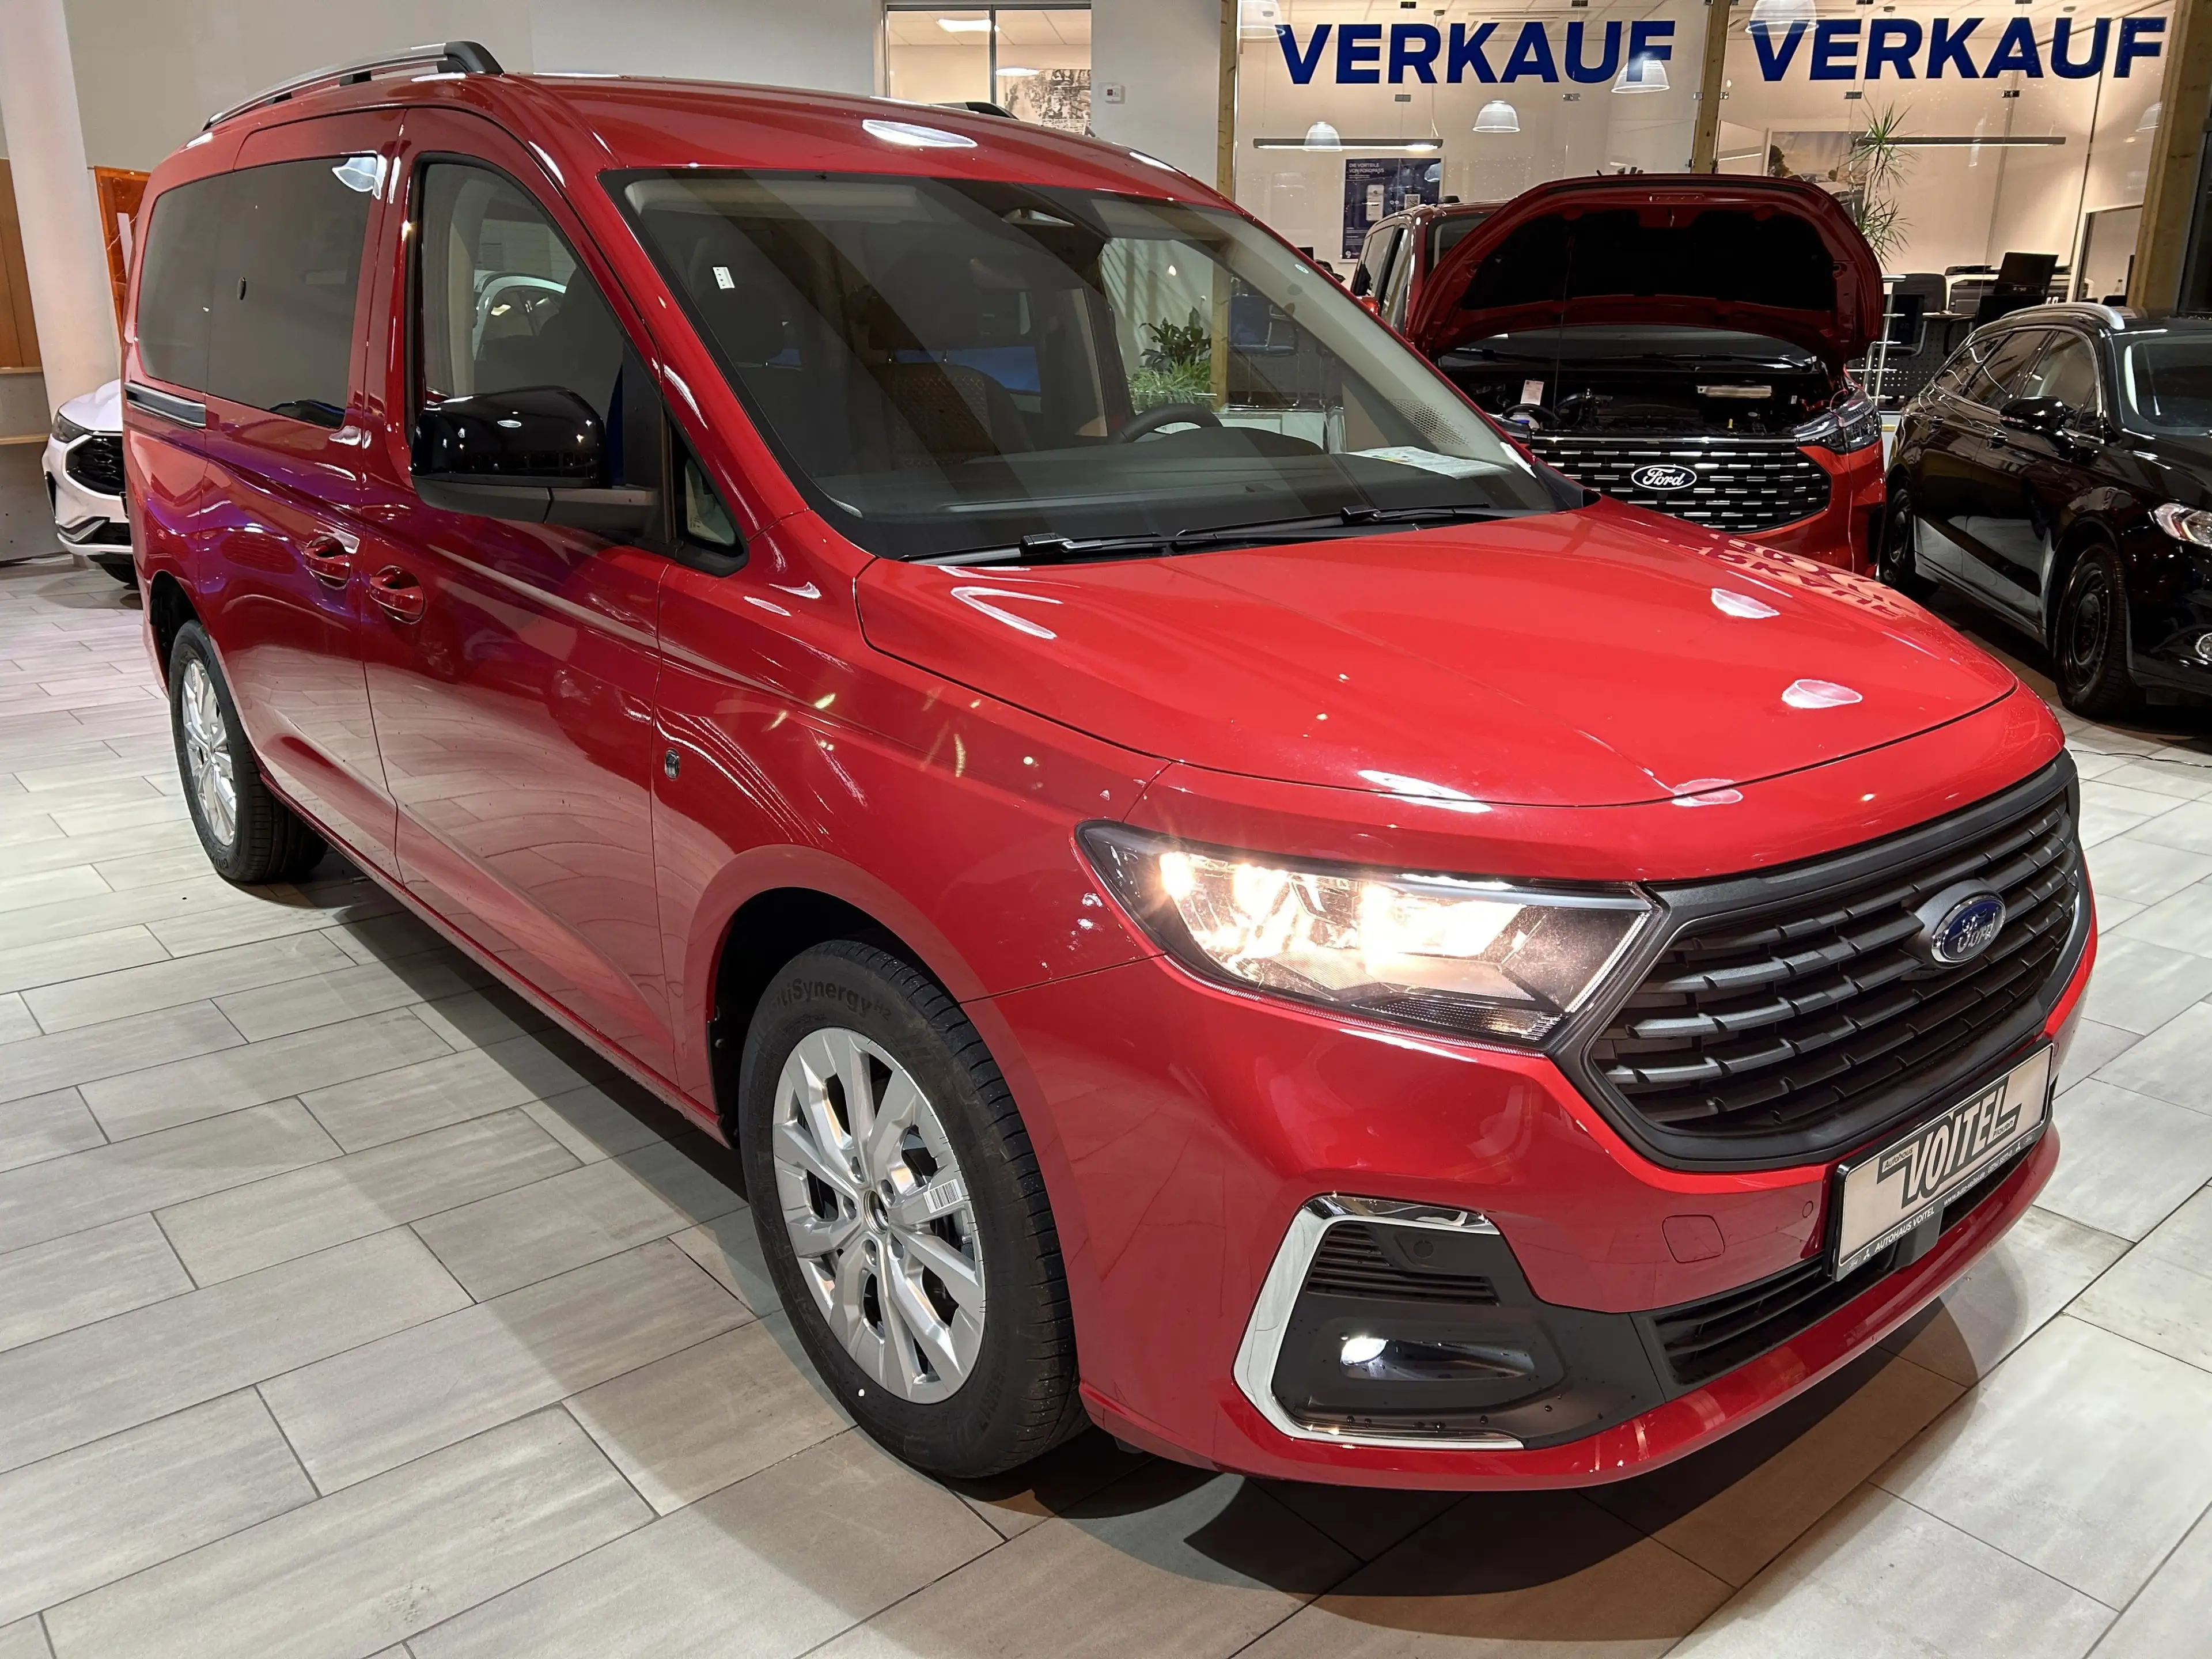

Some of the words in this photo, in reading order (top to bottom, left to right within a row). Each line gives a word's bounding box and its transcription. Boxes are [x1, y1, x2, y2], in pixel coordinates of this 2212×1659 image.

[1274, 20, 1676, 85] VERKAUF
[1749, 16, 2167, 82] VERKAUF
[1642, 467, 1686, 486] Ford
[1957, 908, 1996, 953] Ford
[1895, 1082, 2010, 1201] VOITEL
[1993, 1120, 2013, 1139] Plauen
[1884, 1147, 1914, 1170] Autohaus
[1874, 1221, 1912, 1253] AUTOHAUS
[1913, 1206, 1935, 1226] VOITEL
